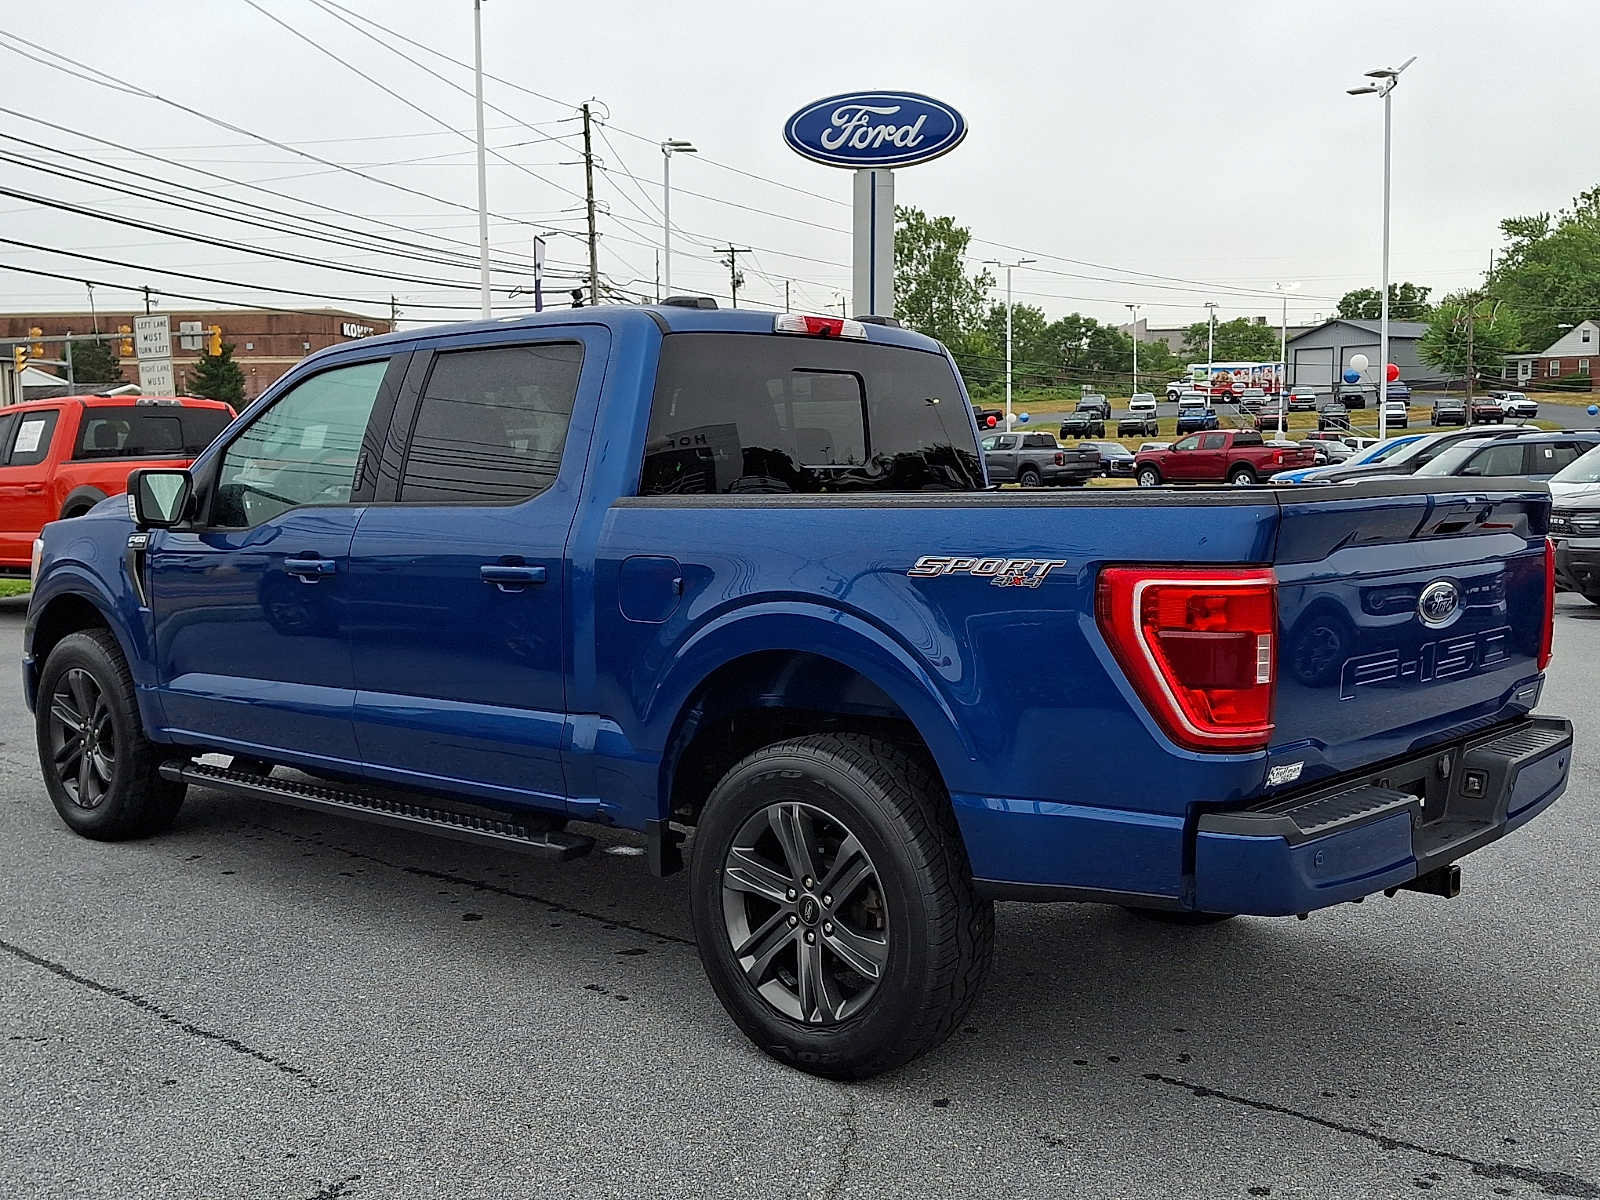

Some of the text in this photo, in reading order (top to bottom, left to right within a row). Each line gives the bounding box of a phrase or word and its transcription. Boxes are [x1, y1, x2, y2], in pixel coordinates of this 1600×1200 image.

[821, 104, 928, 150] Ford
[137, 320, 167, 330] LEFT LANE
[143, 332, 162, 342] MUST
[154, 345, 168, 353] LEFT
[147, 376, 165, 385] MUST
[907, 555, 1068, 578] SPORT
[1338, 625, 1513, 701] F-150
